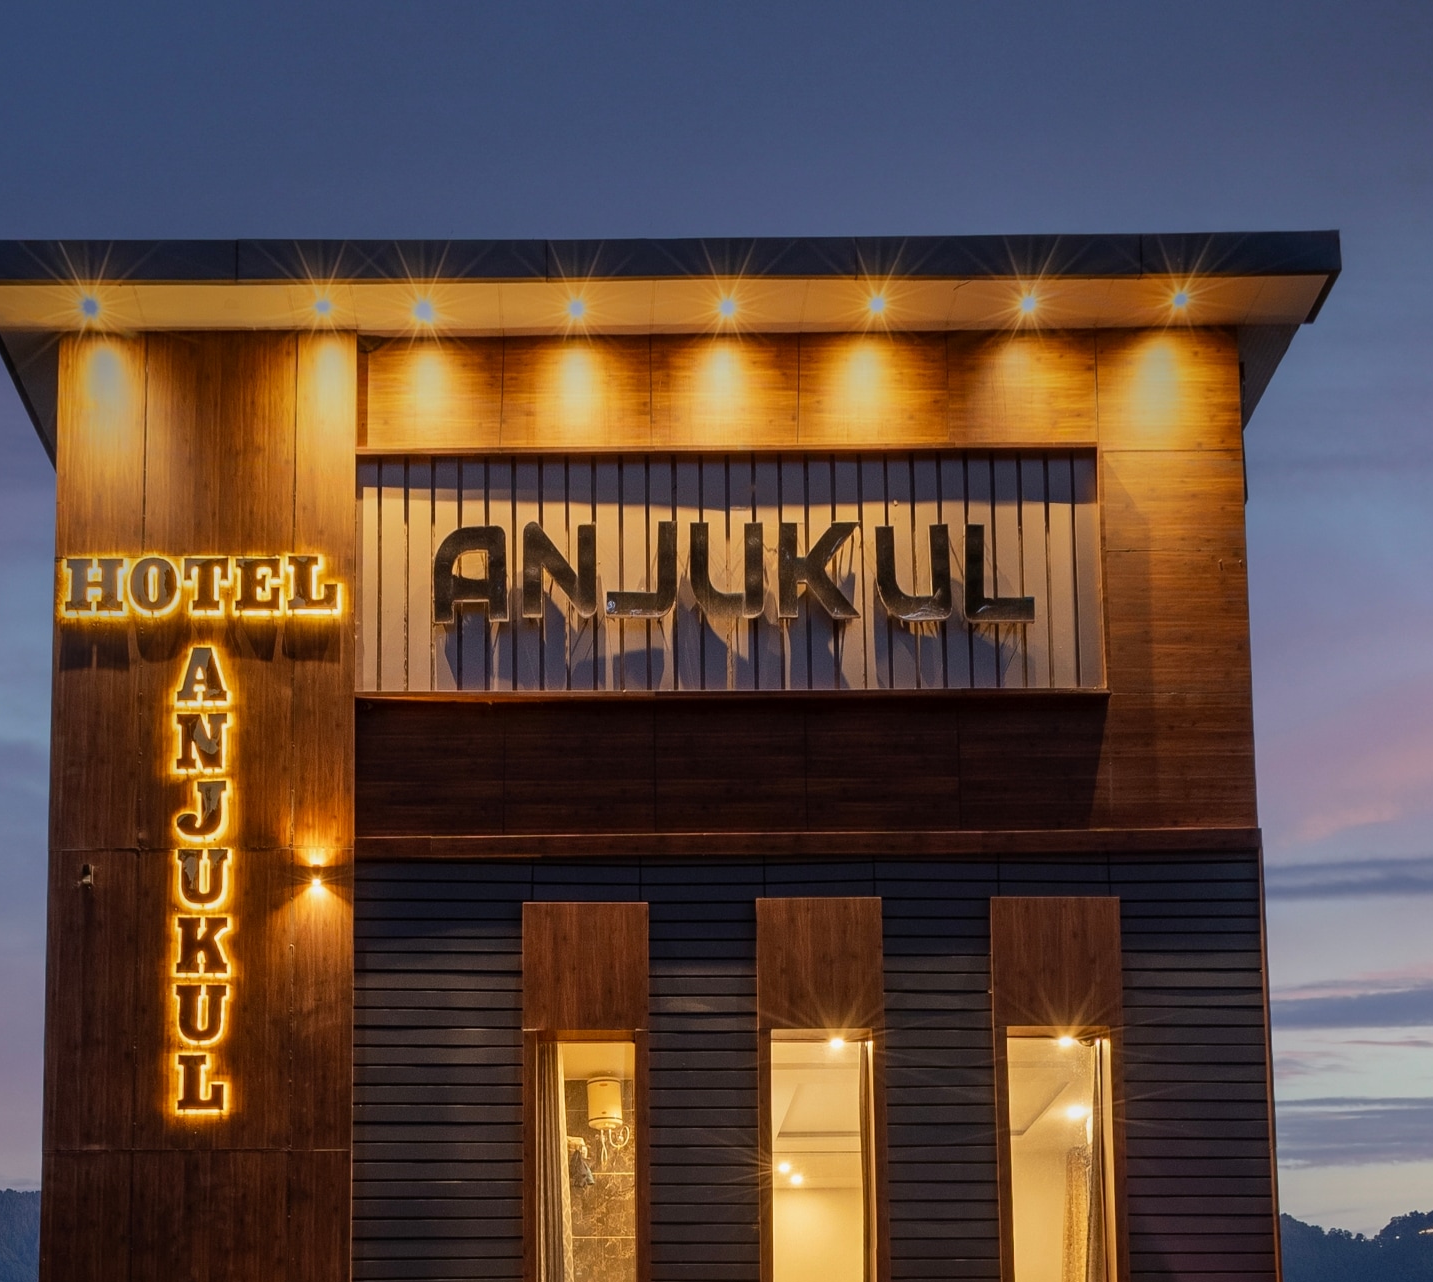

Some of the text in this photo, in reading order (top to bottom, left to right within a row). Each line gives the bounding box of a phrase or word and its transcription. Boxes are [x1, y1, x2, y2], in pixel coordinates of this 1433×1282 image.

[63, 555, 341, 615] HOTEL
[432, 521, 1036, 625] ANJUKUL
[173, 646, 231, 1113] ANJUKUL
